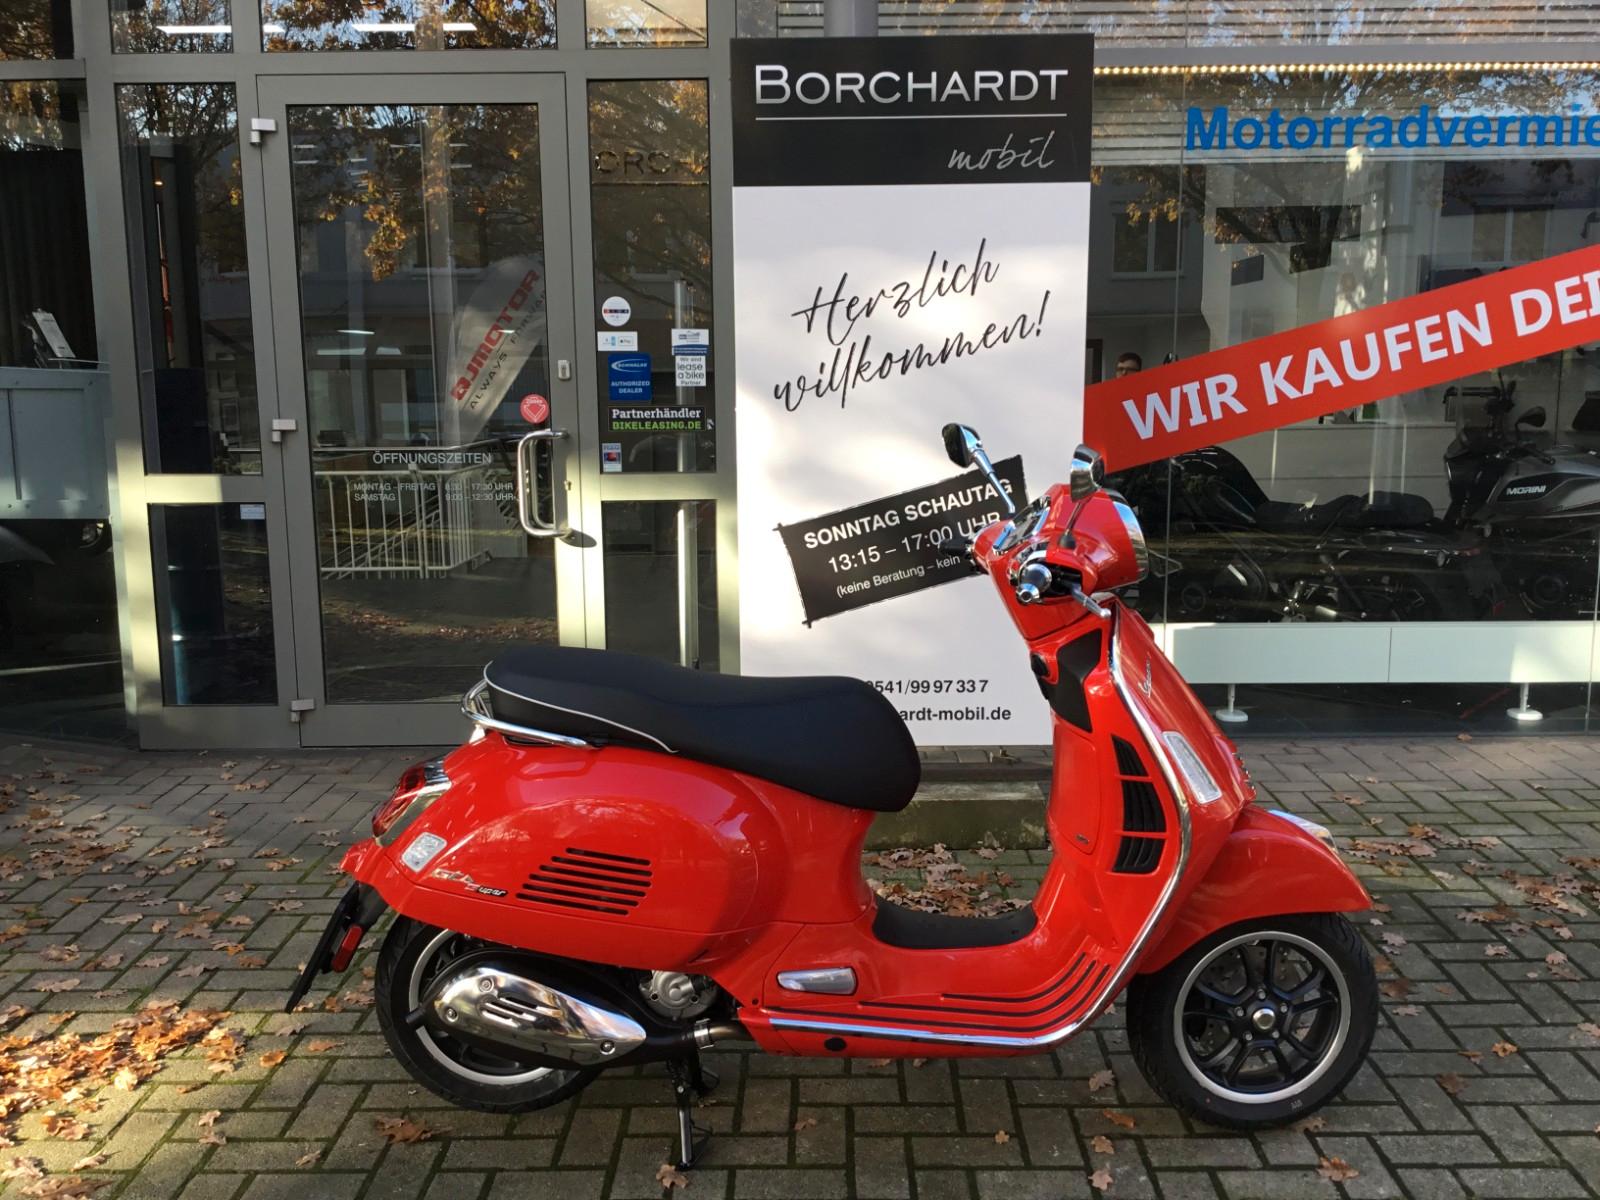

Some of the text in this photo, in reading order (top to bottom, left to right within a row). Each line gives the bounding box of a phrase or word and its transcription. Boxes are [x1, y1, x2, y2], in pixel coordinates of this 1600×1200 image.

[755, 64, 1069, 105] BORCHARDT
[947, 130, 1055, 171] mobil
[791, 237, 1001, 345] Herzlich
[677, 362, 703, 371] lease
[773, 290, 1051, 411] willkommen!
[470, 353, 507, 410] ALWAYS
[1122, 373, 1248, 442] WIR
[1259, 301, 1493, 407] KAUFEN
[612, 408, 702, 419] Partnerhändler
[612, 421, 702, 430] BIKELEASING.DE
[372, 451, 492, 465] ÖFFNUNGSZEITEN
[353, 482, 391, 491] MONTAG
[400, 482, 436, 491] FREITAG
[495, 482, 513, 491] UHR
[354, 493, 396, 501] SAMSTAG
[472, 493, 493, 501] 12:30
[495, 493, 514, 501] UHR
[803, 477, 1014, 549] SONNTAG SCHAUTAG
[828, 548, 881, 575] 13:15
[900, 527, 953, 554] 17:00
[836, 577, 871, 599] (keine
[872, 567, 925, 592] Beratung
[936, 554, 961, 571] kein
[899, 706, 1012, 721] ardt-mobil.de
